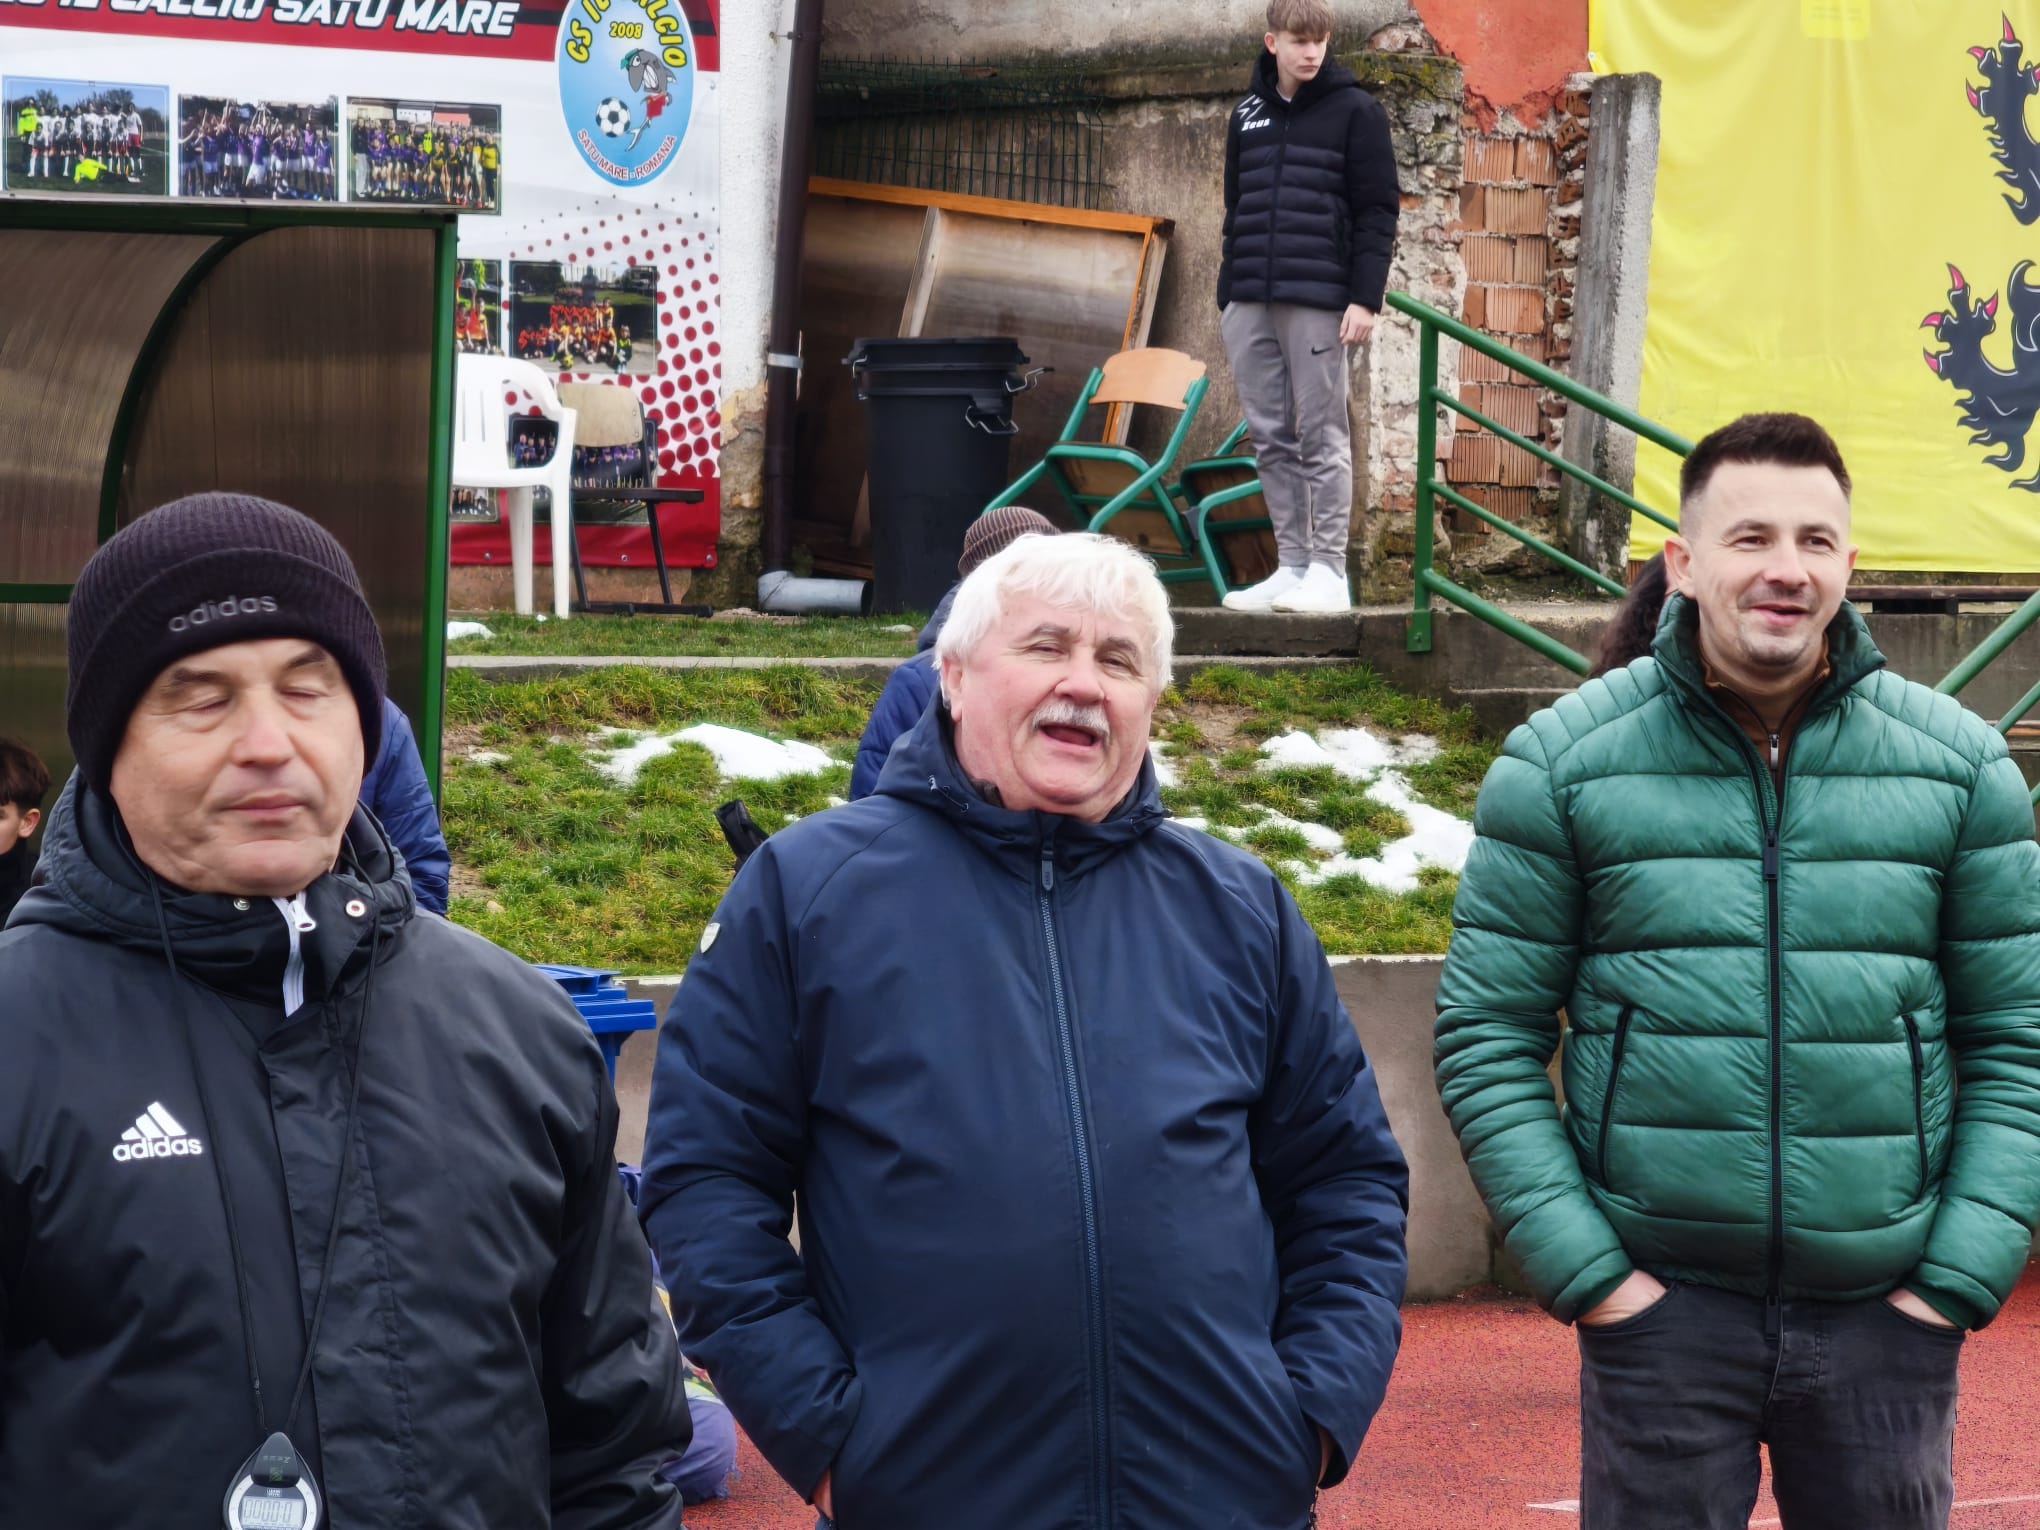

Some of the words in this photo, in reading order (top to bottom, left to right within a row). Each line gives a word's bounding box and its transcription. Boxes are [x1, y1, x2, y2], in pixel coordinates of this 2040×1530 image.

[273, 0, 389, 27] SATU
[395, 0, 520, 36] MARE
[609, 21, 643, 39] 2008
[565, 18, 593, 63] CS
[577, 128, 600, 164] SATU
[598, 158, 629, 181] MARE
[634, 135, 677, 180] ROMANIA
[168, 595, 278, 632] adidas
[112, 1136, 203, 1162] adidas
